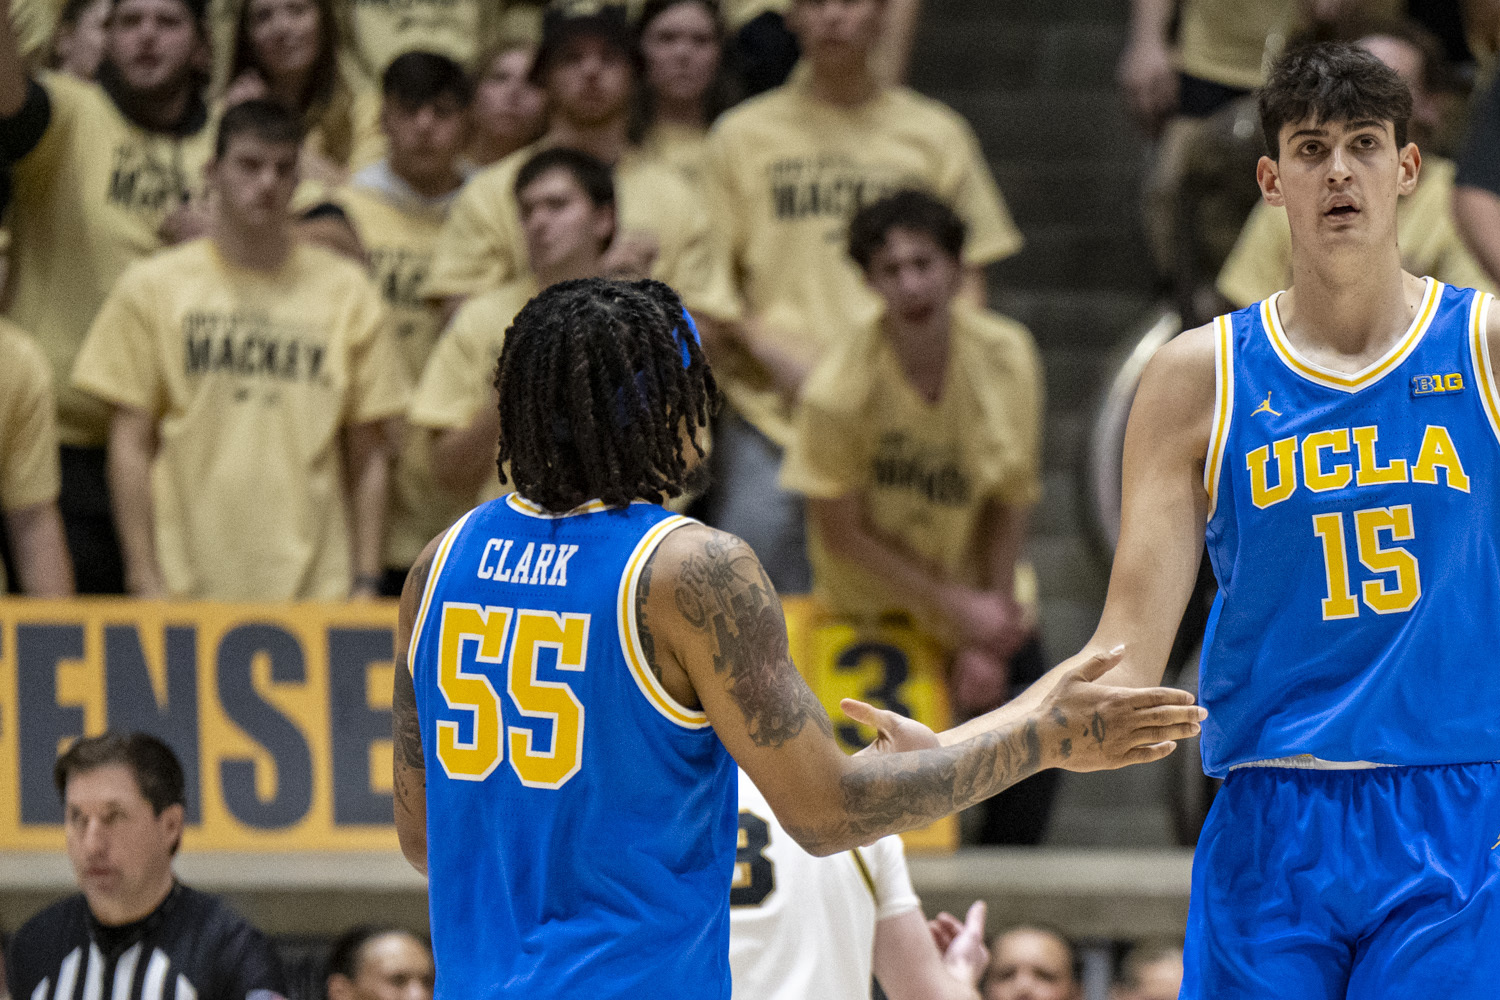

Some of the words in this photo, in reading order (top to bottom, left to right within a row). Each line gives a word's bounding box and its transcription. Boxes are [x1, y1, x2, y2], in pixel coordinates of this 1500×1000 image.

[1246, 424, 1471, 510] UCLA
[477, 537, 579, 587] CLARK
[1312, 503, 1422, 621] 15
[0, 620, 398, 832] ENSE
[436, 601, 591, 790] 55
[838, 637, 910, 748] 3
